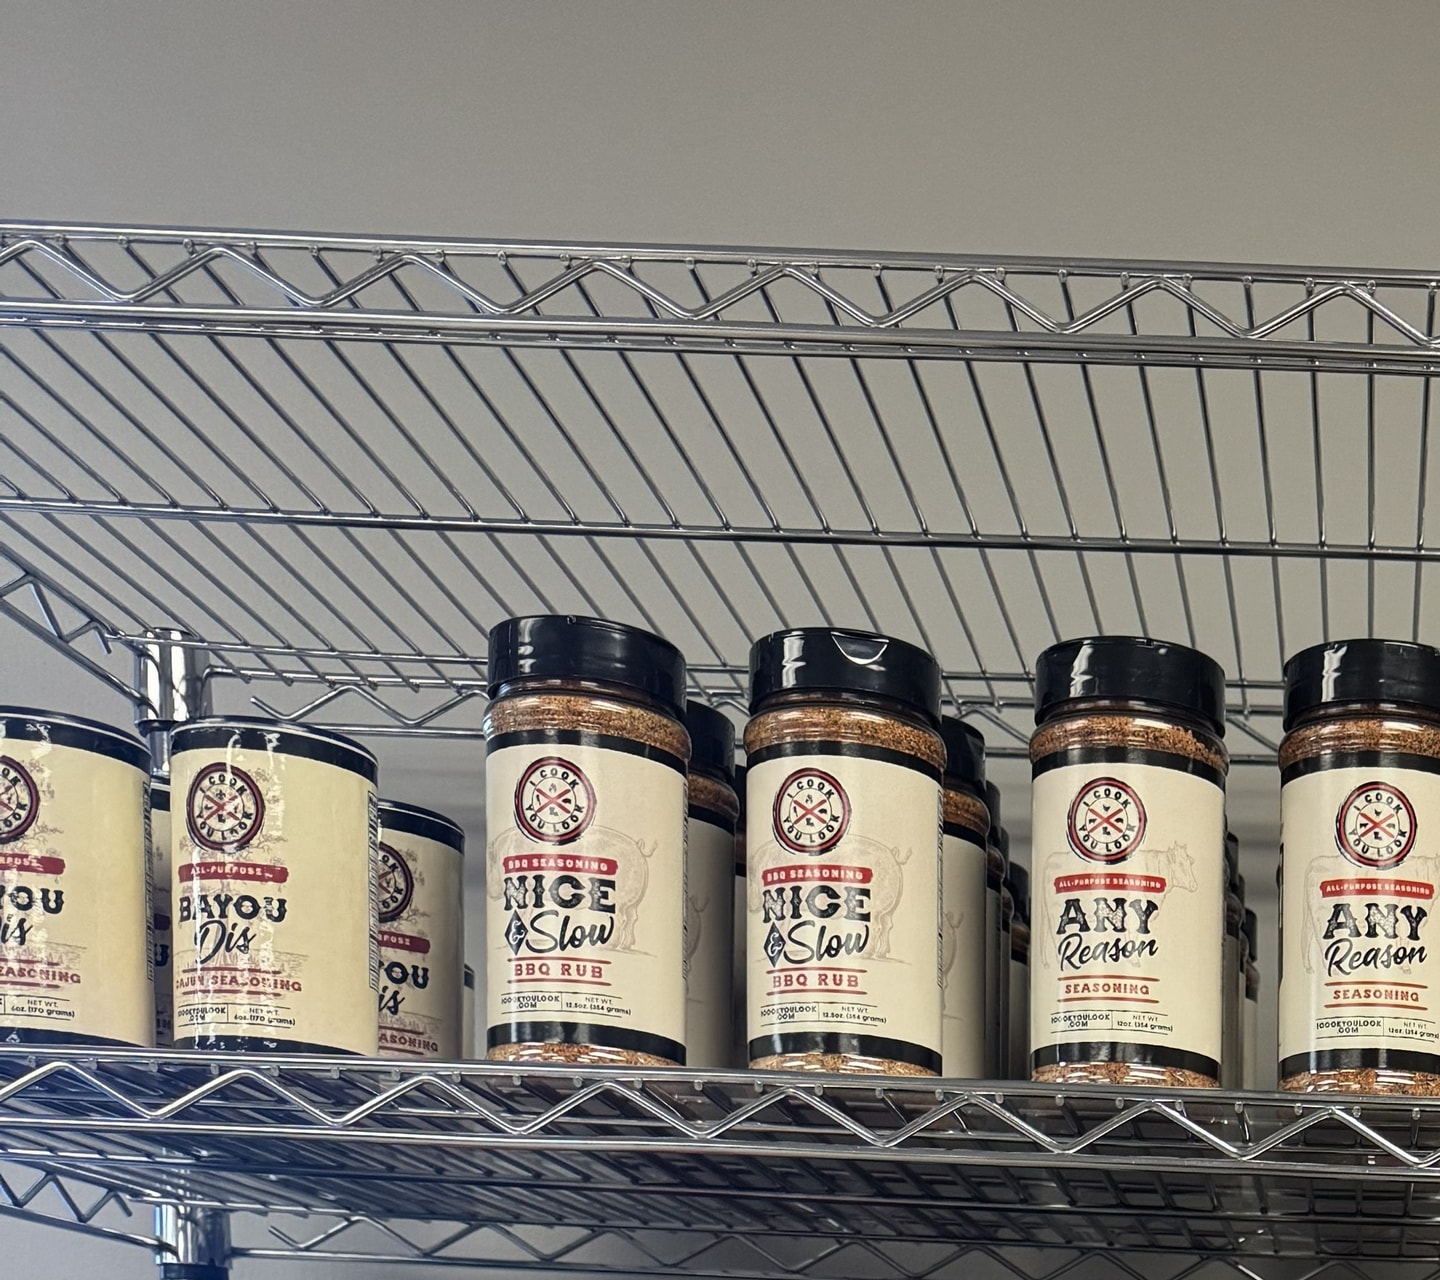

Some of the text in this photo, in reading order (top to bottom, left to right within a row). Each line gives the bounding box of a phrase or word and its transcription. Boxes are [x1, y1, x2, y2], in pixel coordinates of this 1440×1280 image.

[532, 859, 608, 871] SEASONING
[179, 894, 288, 922] BAYOU
[503, 874, 616, 914] NICE
[762, 886, 872, 923] NICE
[526, 910, 614, 953] Slow
[1056, 897, 1160, 936] ANY
[1323, 902, 1428, 942] ANY
[197, 919, 256, 964] Dis
[785, 920, 870, 964] Slow
[1058, 932, 1159, 972] Reason
[1325, 937, 1428, 978] Reason
[514, 963, 603, 978] BBQ RUB
[1064, 982, 1150, 996] SEASONING
